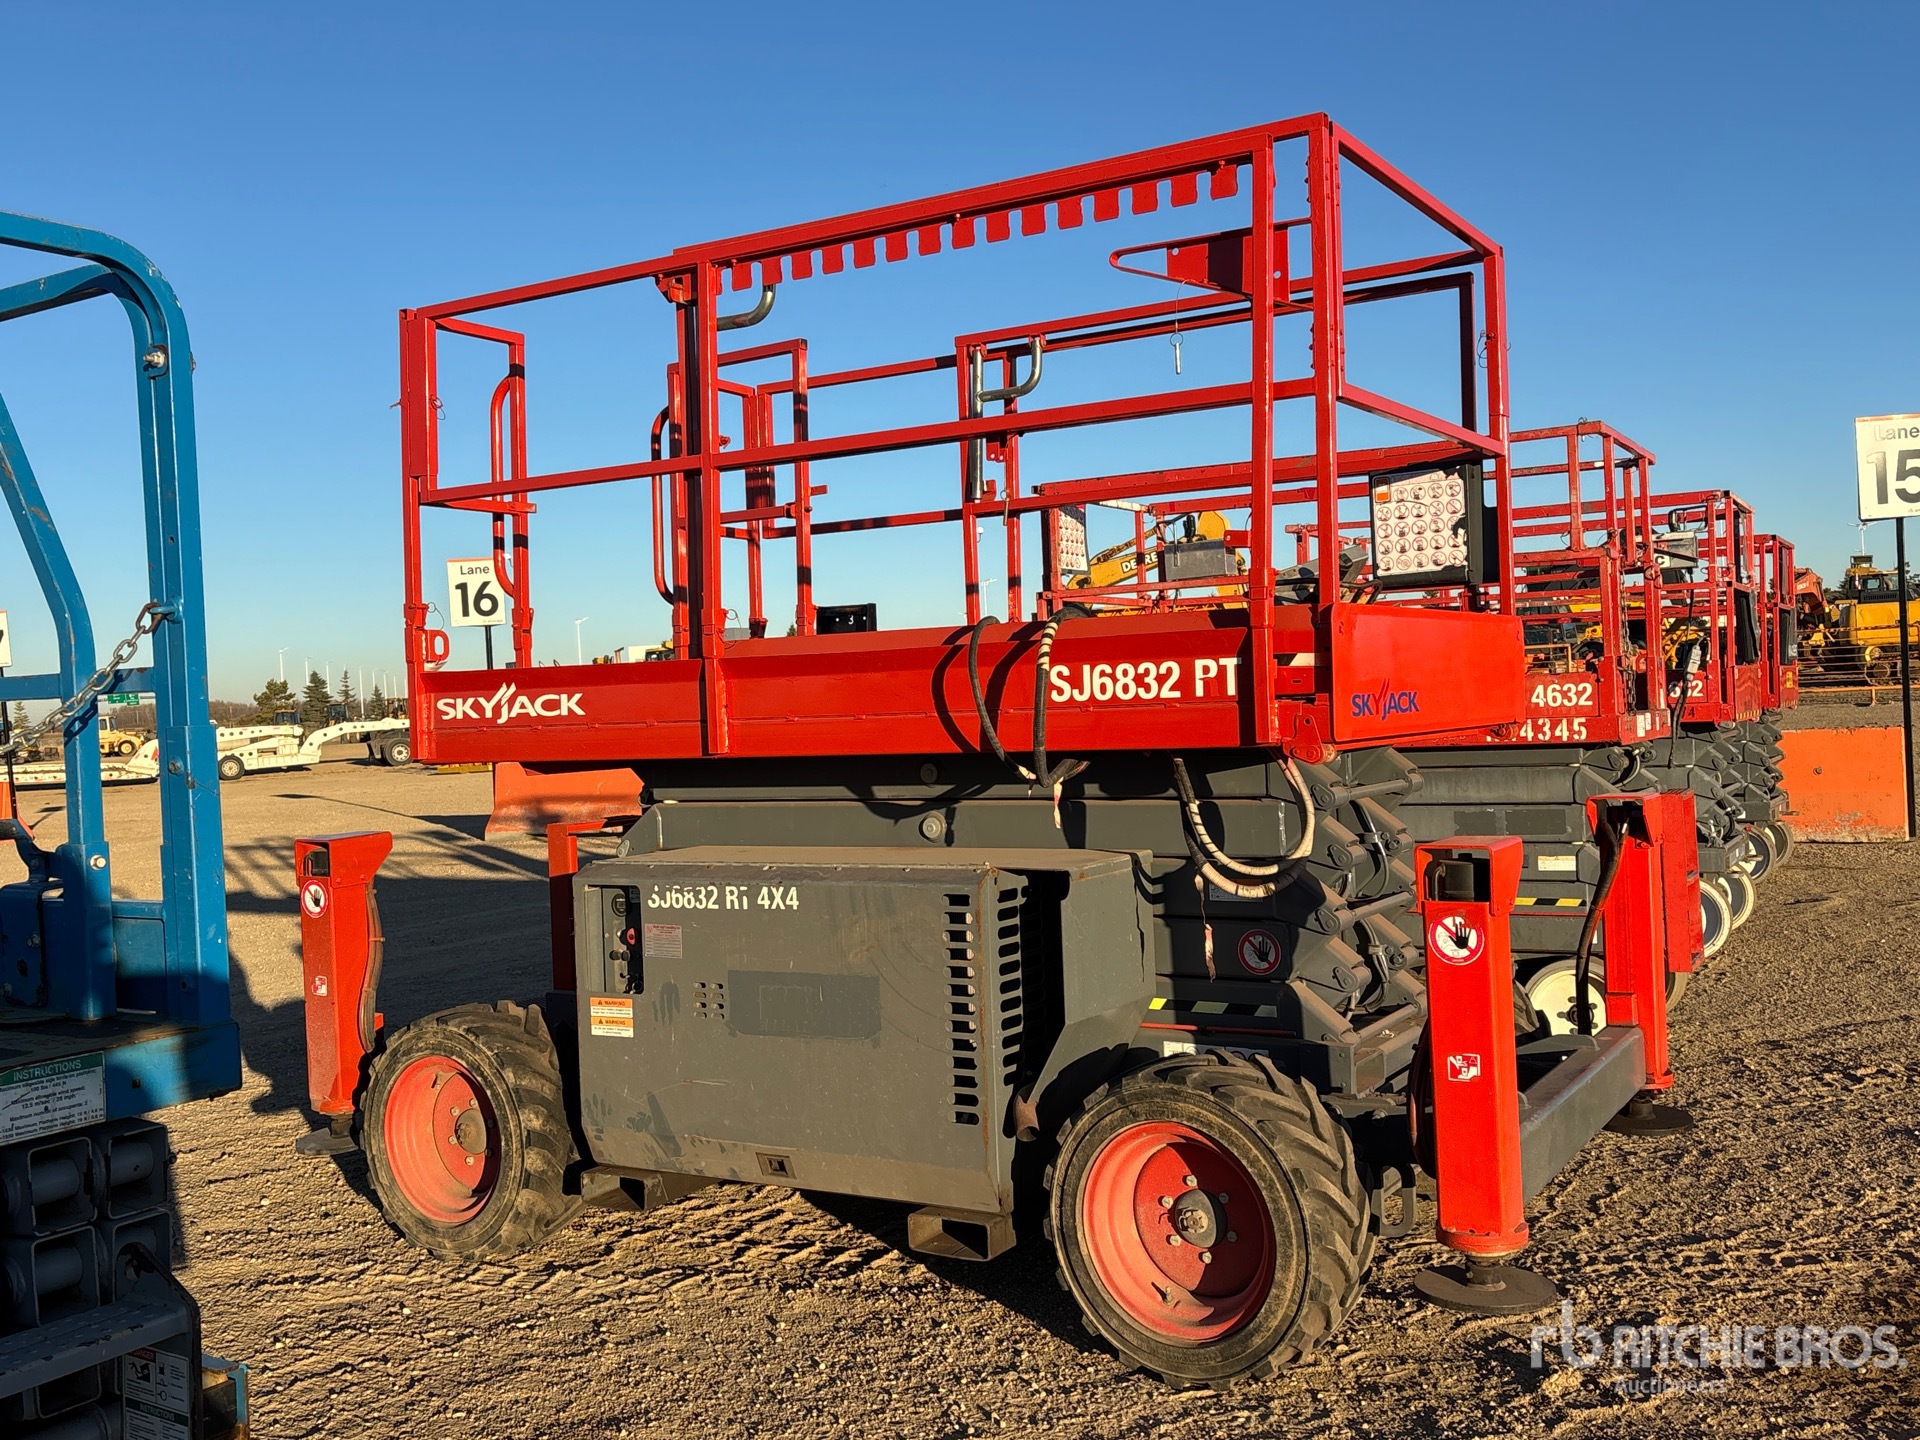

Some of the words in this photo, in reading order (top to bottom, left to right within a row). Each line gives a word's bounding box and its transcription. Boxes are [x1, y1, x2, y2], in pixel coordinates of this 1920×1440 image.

[1867, 449, 1920, 505] 15
[460, 565, 490, 575] Lane
[1122, 552, 1158, 573] DERE
[455, 581, 499, 617] 16
[1050, 661, 1182, 702] SJ6832
[1531, 682, 1593, 707] 4632
[436, 682, 586, 724] SKYJACK
[1351, 678, 1420, 721] SKYJACK
[757, 886, 800, 910] 4X4
[13, 1059, 82, 1081] INSTRUCTIONS
